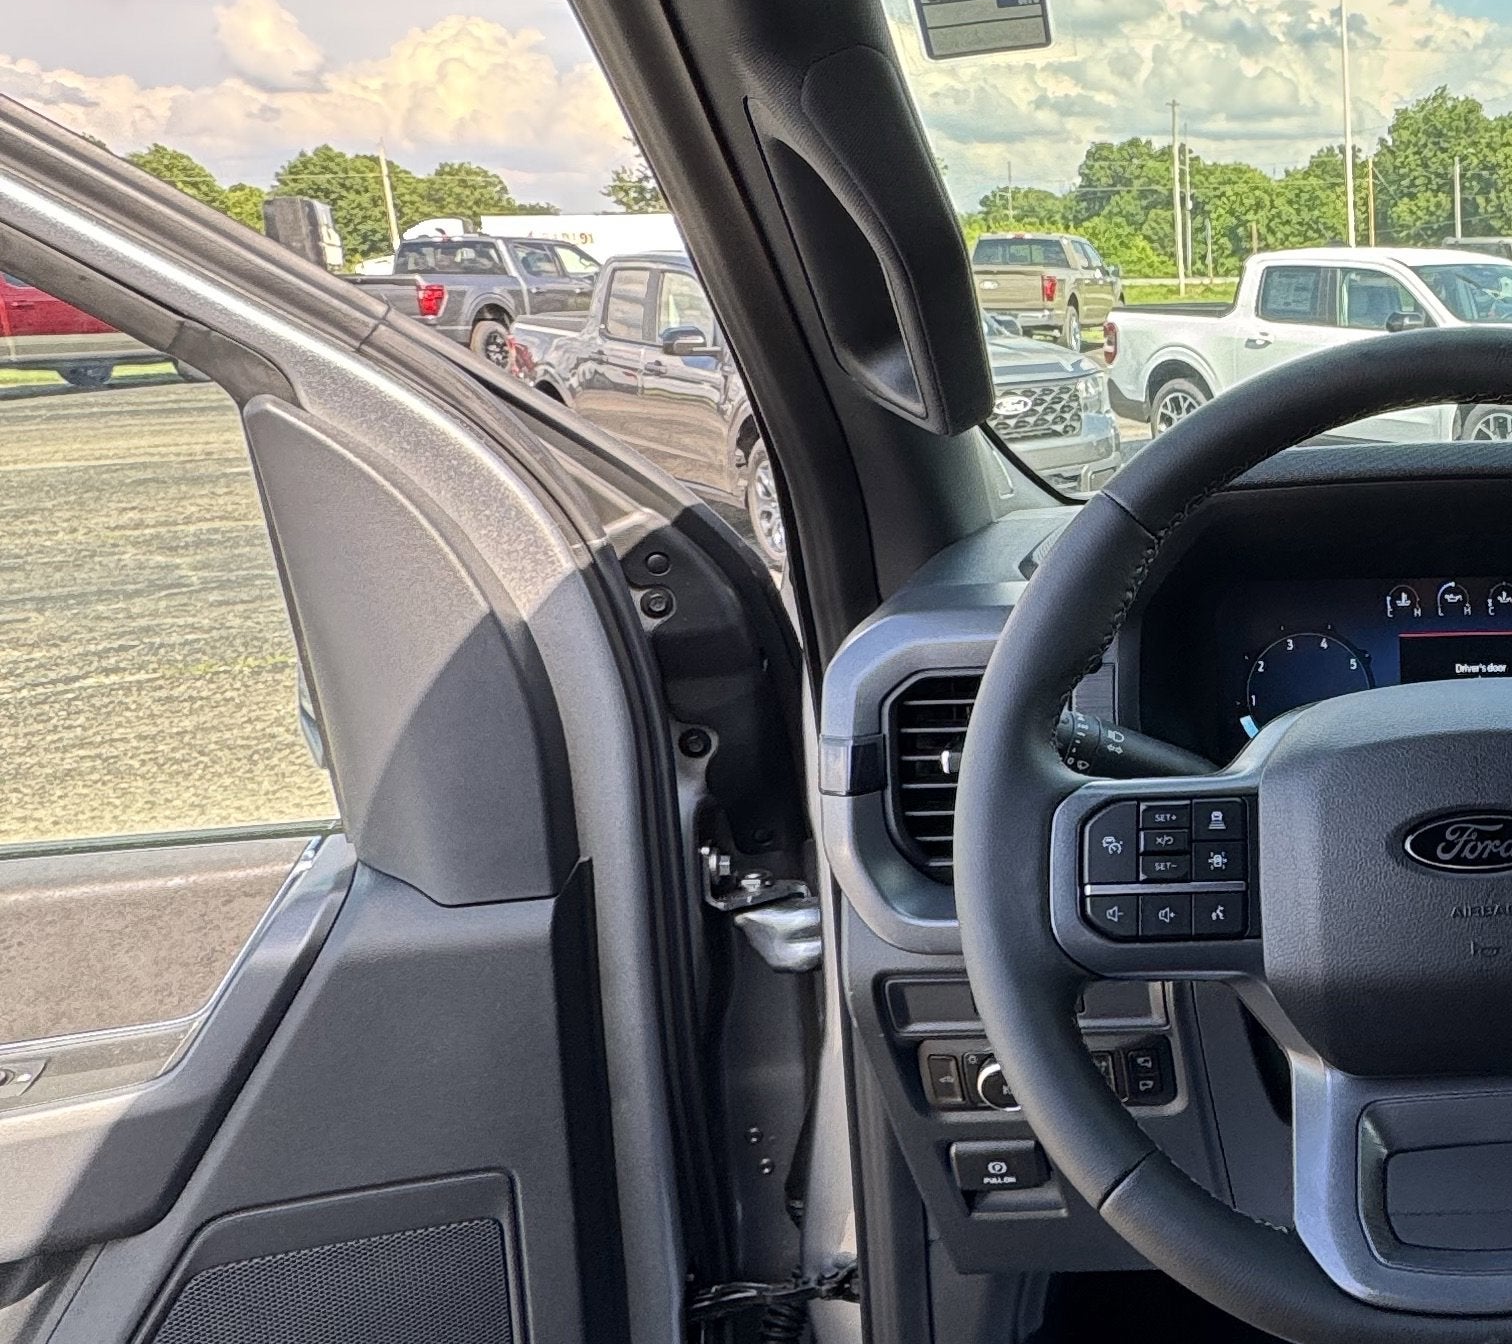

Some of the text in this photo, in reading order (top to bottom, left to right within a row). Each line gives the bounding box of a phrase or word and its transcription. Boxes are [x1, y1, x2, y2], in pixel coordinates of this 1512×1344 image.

[1286, 638, 1294, 651] 3
[1320, 637, 1328, 650] 4
[1257, 660, 1264, 672] 2
[1350, 658, 1357, 670] 5
[1154, 813, 1177, 823] SET+
